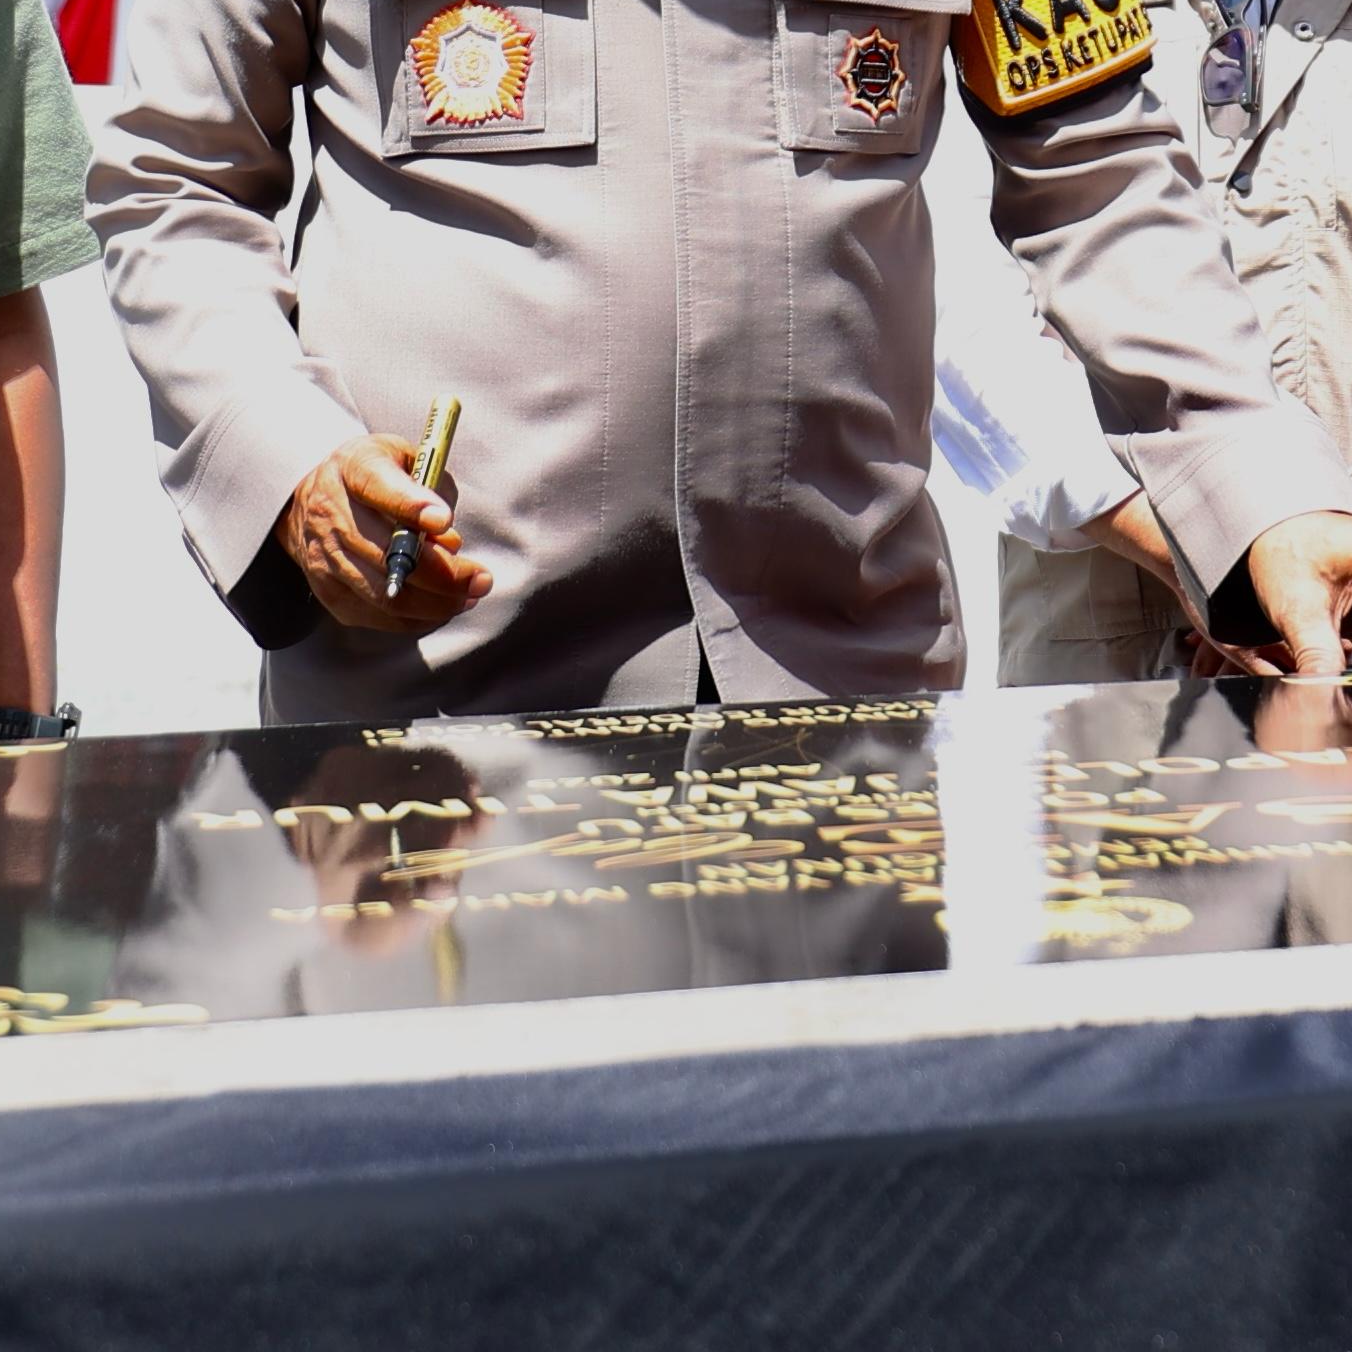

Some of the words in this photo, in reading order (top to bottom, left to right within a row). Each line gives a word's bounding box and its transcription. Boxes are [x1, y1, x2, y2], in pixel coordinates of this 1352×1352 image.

[1007, 48, 1060, 91] OPS
[1060, 7, 1145, 72] KETUPAT
[412, 451, 428, 481] OLD
[600, 773, 899, 807] JAWA
[835, 787, 1167, 822] POES
[191, 794, 581, 830] TIMUR
[578, 808, 815, 838] BATU
[411, 885, 629, 912] MAHA
[648, 874, 832, 900] YANG
[269, 900, 394, 924] ESA
